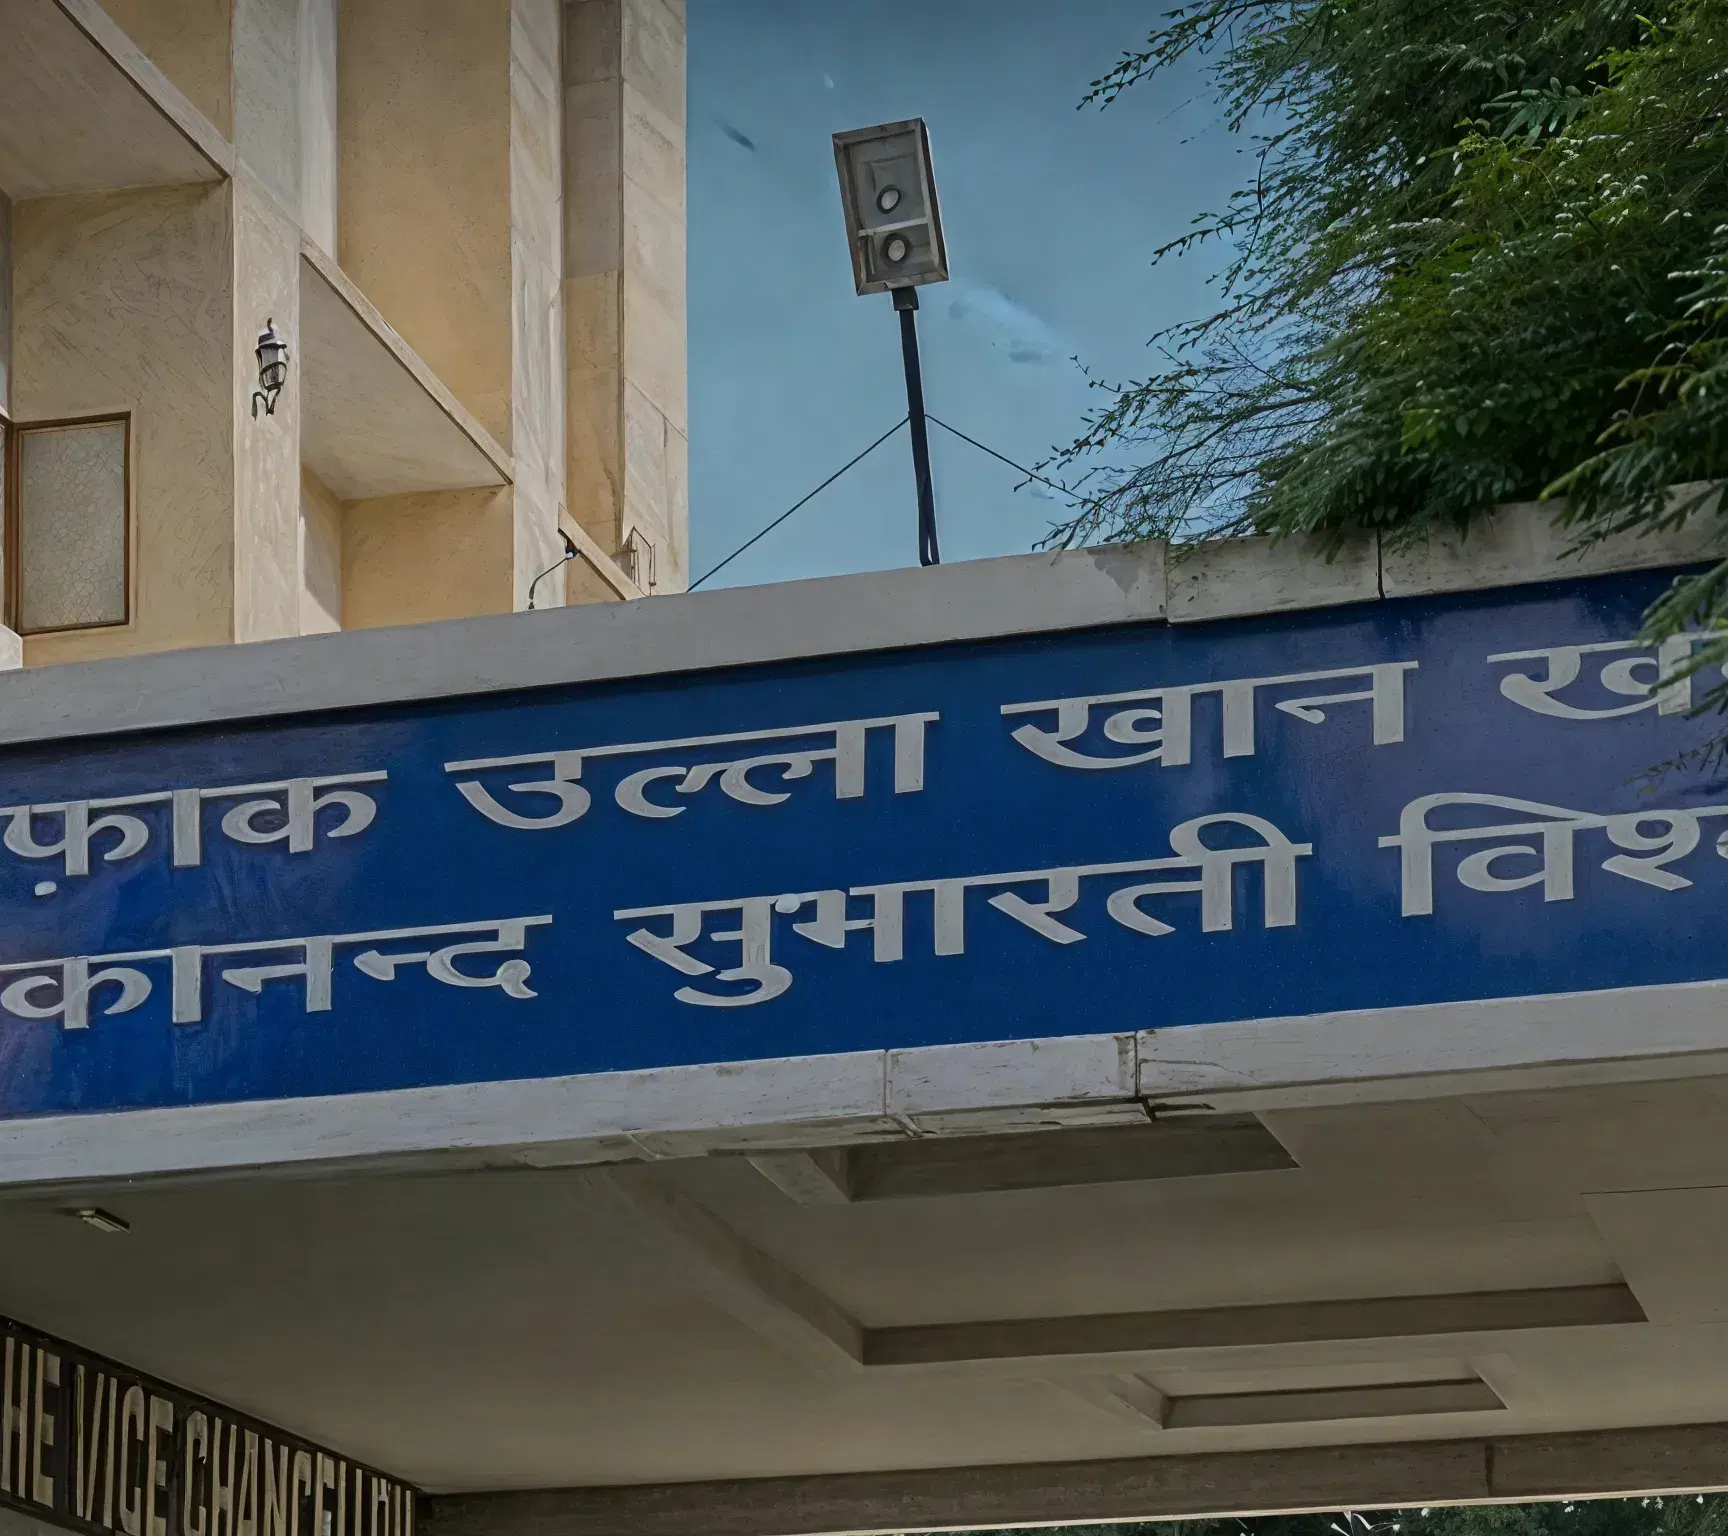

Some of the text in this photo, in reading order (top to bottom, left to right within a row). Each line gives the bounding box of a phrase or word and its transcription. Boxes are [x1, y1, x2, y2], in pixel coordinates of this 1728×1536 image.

[444, 710, 942, 830] उल्ला
[1001, 658, 1418, 772] खान
[614, 810, 1314, 1008] सुभारती
